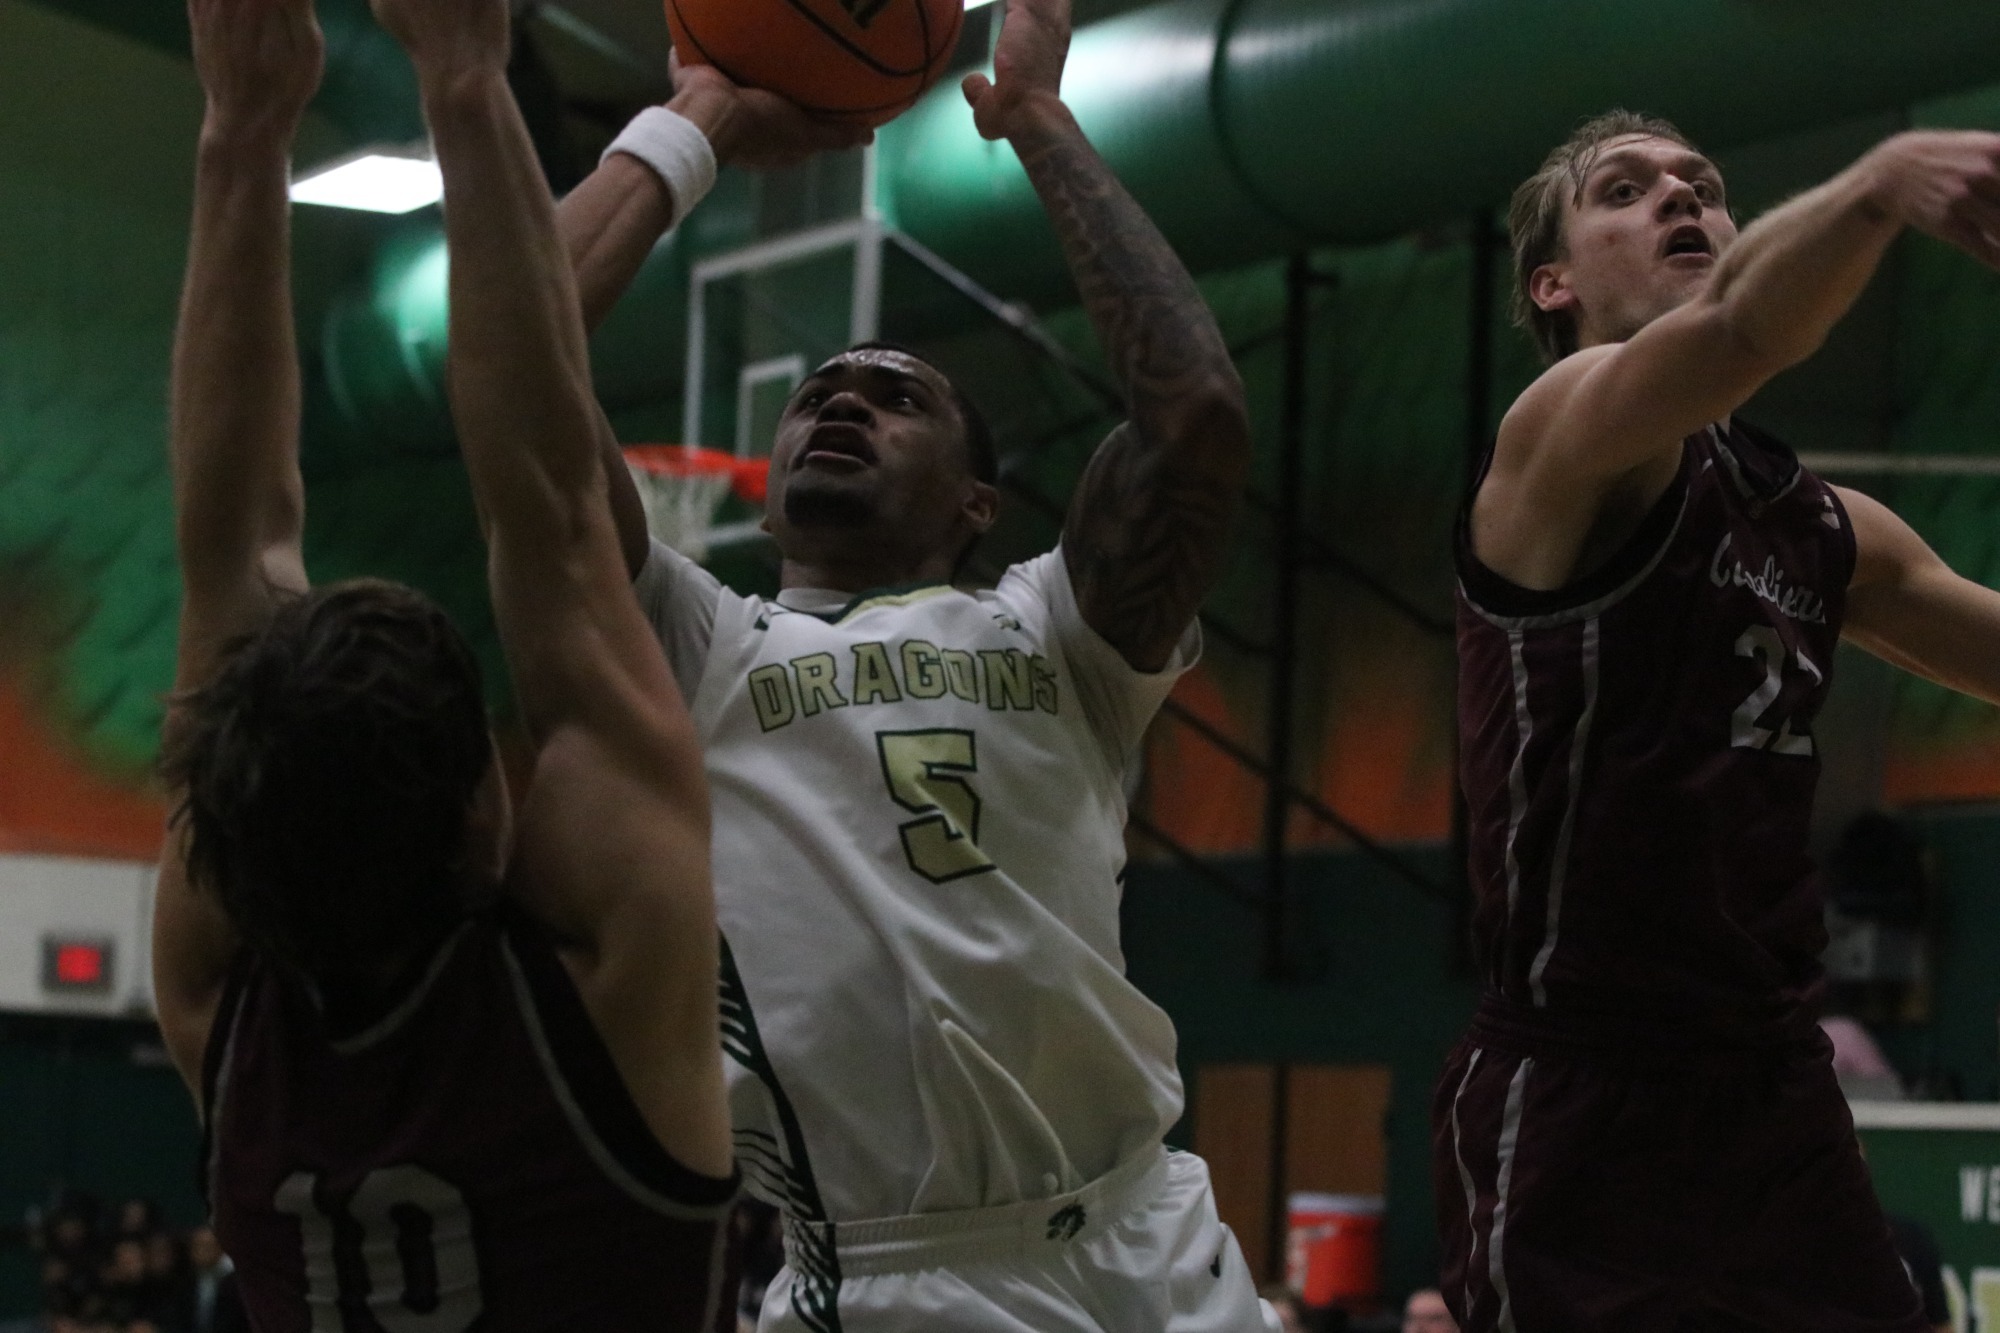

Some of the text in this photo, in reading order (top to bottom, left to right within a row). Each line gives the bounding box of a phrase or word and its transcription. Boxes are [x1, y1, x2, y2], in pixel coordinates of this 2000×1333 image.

[748, 639, 1059, 733] DRAGONS
[876, 728, 998, 885] 5
[272, 1162, 484, 1333] 10
